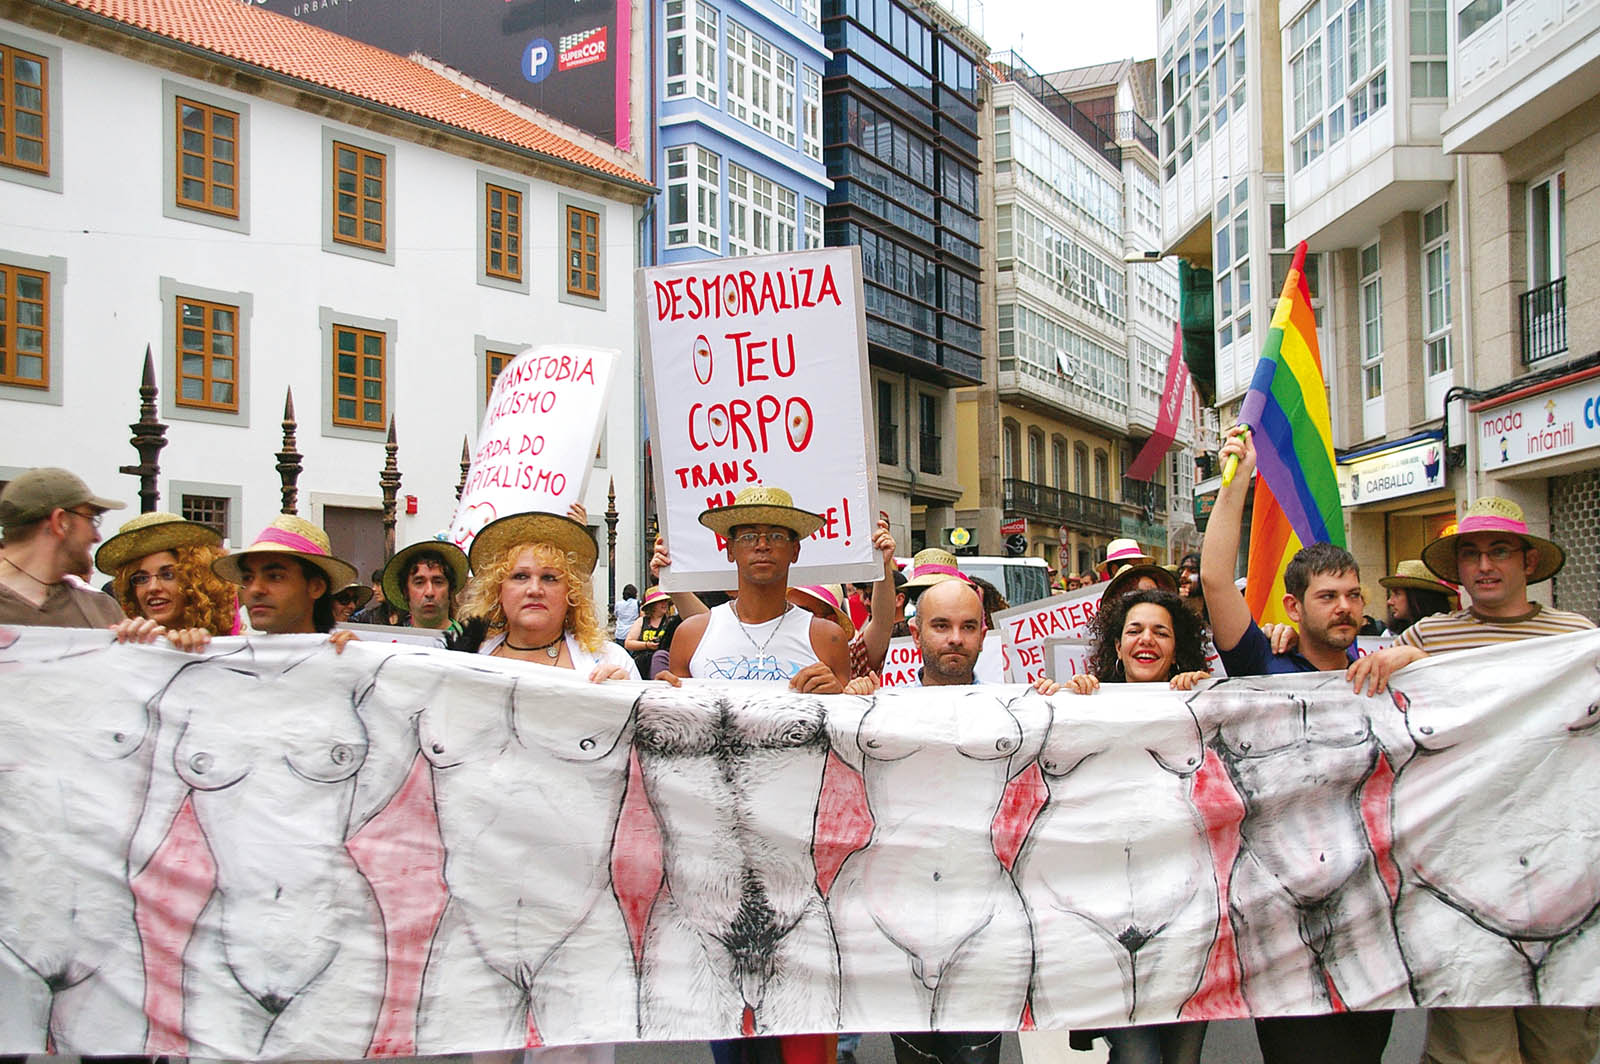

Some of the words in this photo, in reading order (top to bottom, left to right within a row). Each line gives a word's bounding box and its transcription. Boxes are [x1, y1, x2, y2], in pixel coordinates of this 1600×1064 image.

[294, 0, 353, 17] URBAN
[530, 46, 548, 76] P
[560, 40, 606, 63] SUPERCOR
[498, 354, 595, 393] RANSFOBiA
[693, 334, 713, 385] O
[724, 331, 795, 387] TEU
[688, 394, 814, 453] CORPO
[1483, 409, 1522, 437] moda
[1527, 421, 1574, 454] infantil
[474, 436, 511, 465] ERDA
[517, 434, 545, 456] DO
[466, 461, 567, 496] PiTALiSMO
[674, 459, 763, 489] TRANS.
[1366, 471, 1415, 494] CARBALLO
